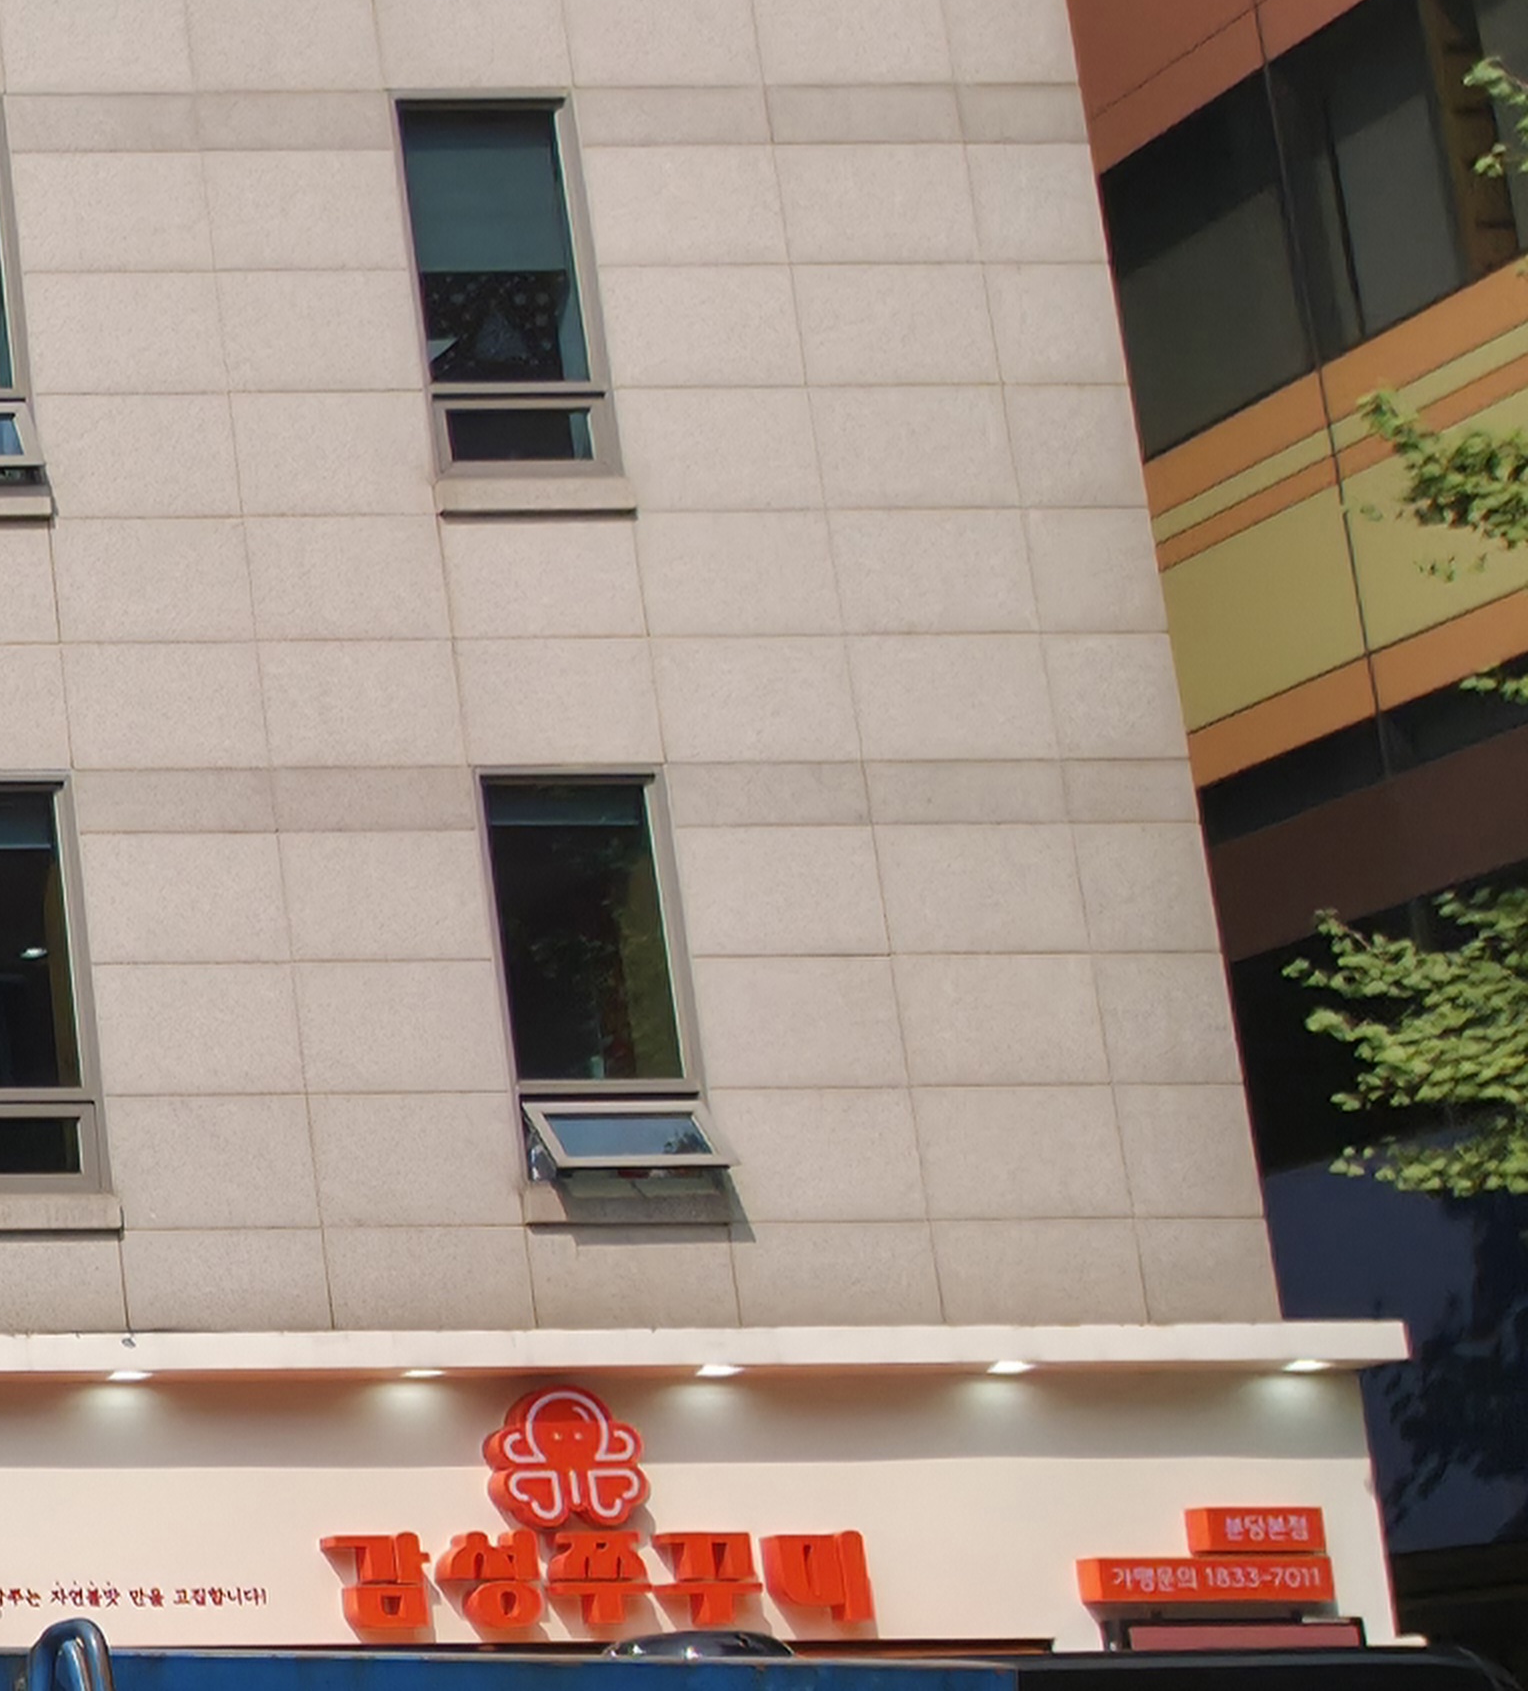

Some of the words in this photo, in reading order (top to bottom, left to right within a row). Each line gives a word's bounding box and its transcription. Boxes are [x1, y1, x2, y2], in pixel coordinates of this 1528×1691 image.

[1224, 1514, 1310, 1542] 분당본점
[1111, 1565, 1199, 1592] 가맹문의
[1204, 1566, 1322, 1589] 1833-7011
